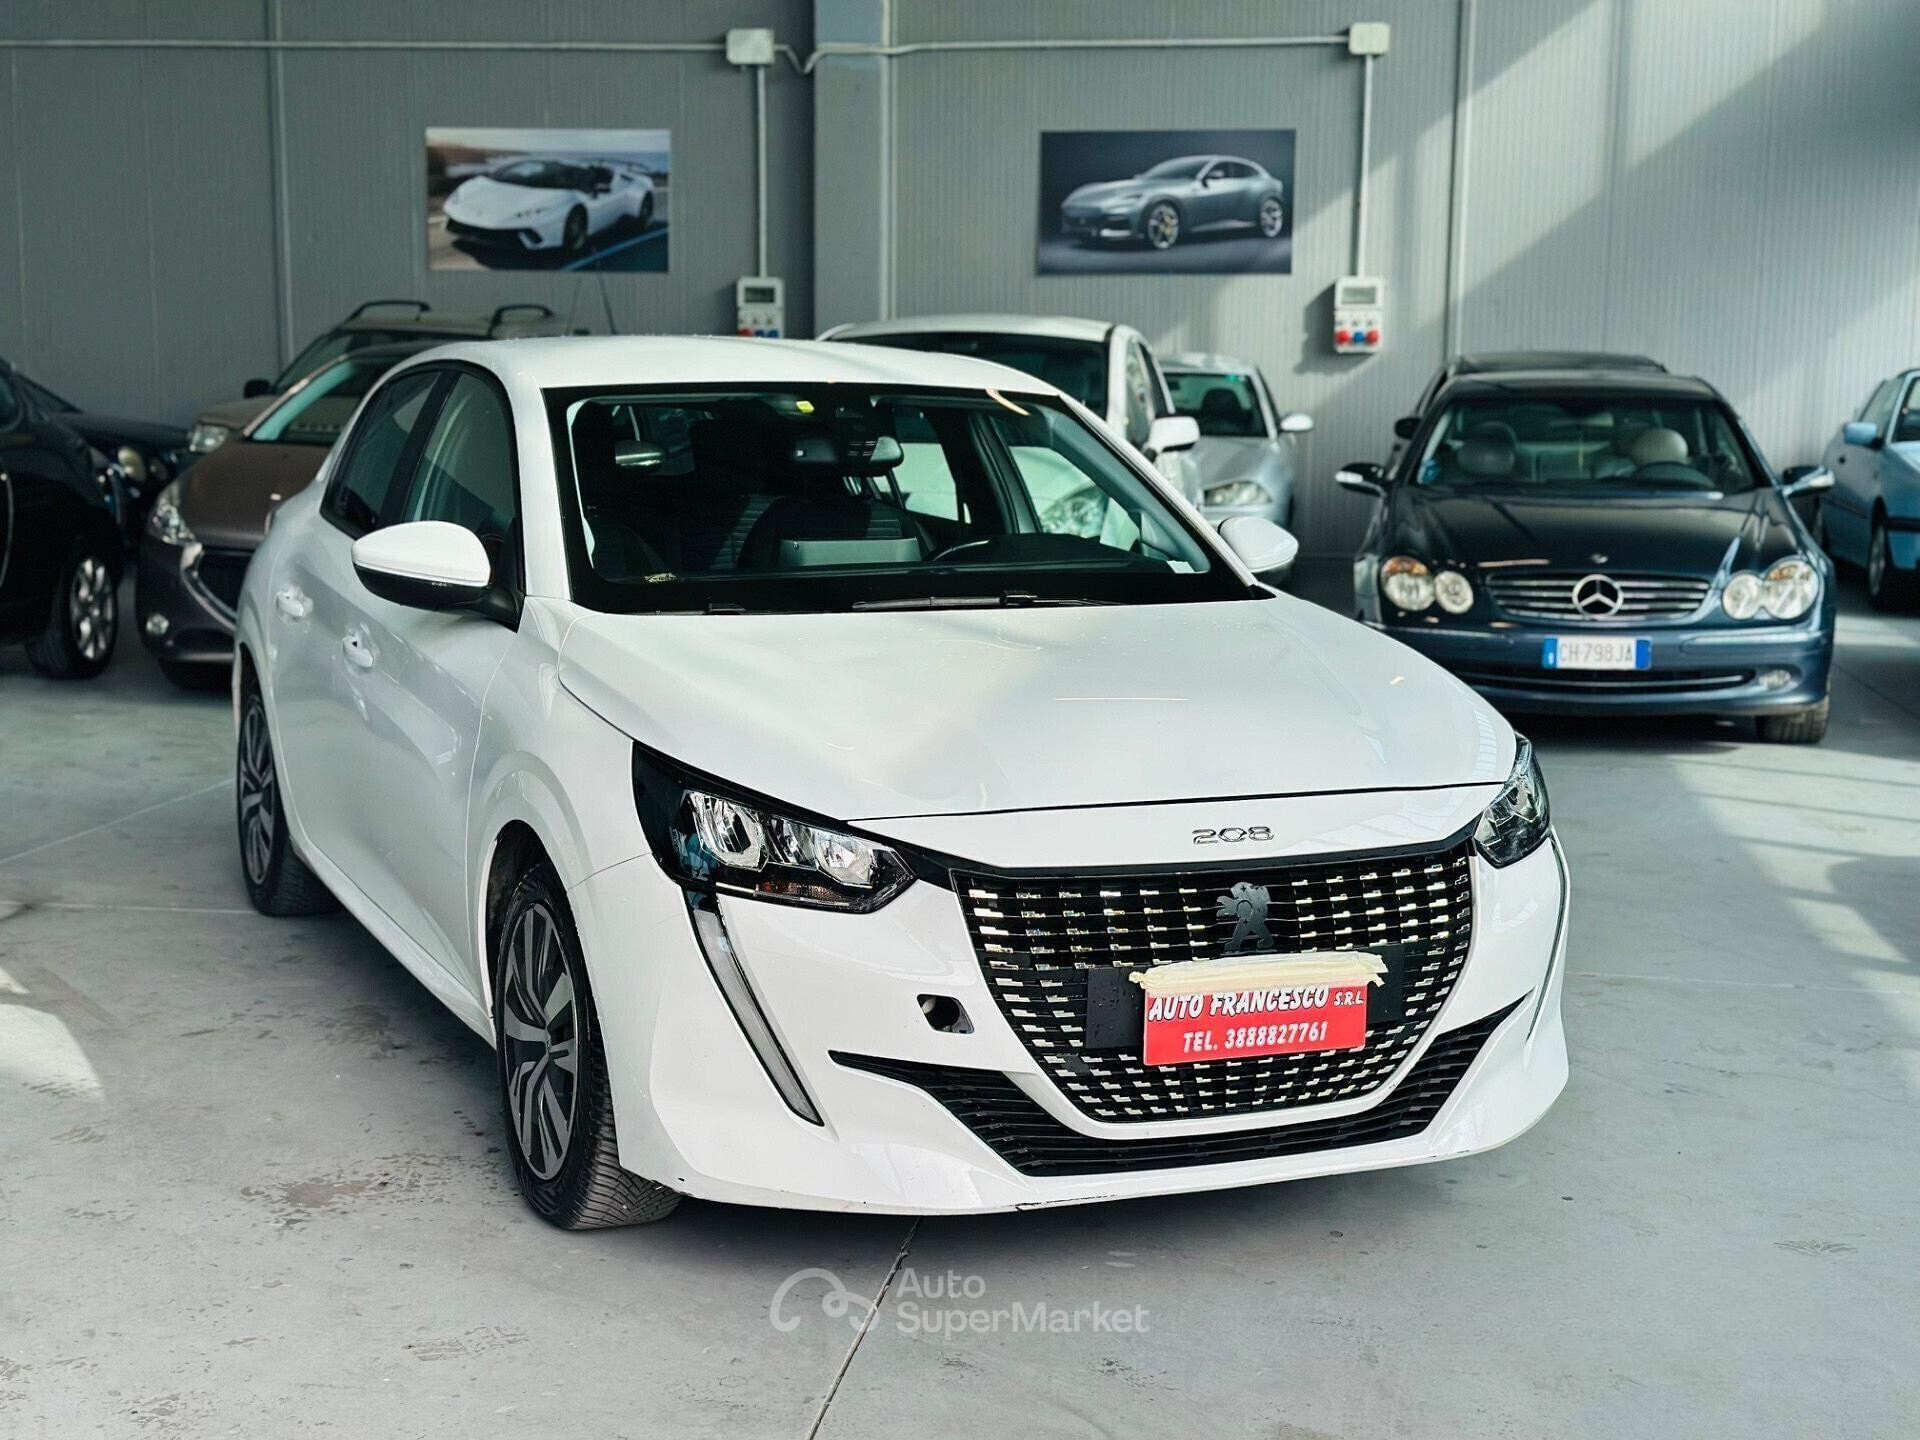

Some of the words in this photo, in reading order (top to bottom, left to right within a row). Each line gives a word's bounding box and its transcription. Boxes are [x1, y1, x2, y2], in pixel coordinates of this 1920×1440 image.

[1192, 826, 1274, 844] 208
[1148, 992, 1204, 1021] AUTO
[1210, 984, 1330, 1017] FRANCESCO
[1183, 1031, 1218, 1053] TEL.
[1224, 1020, 1328, 1049] 3888827761
